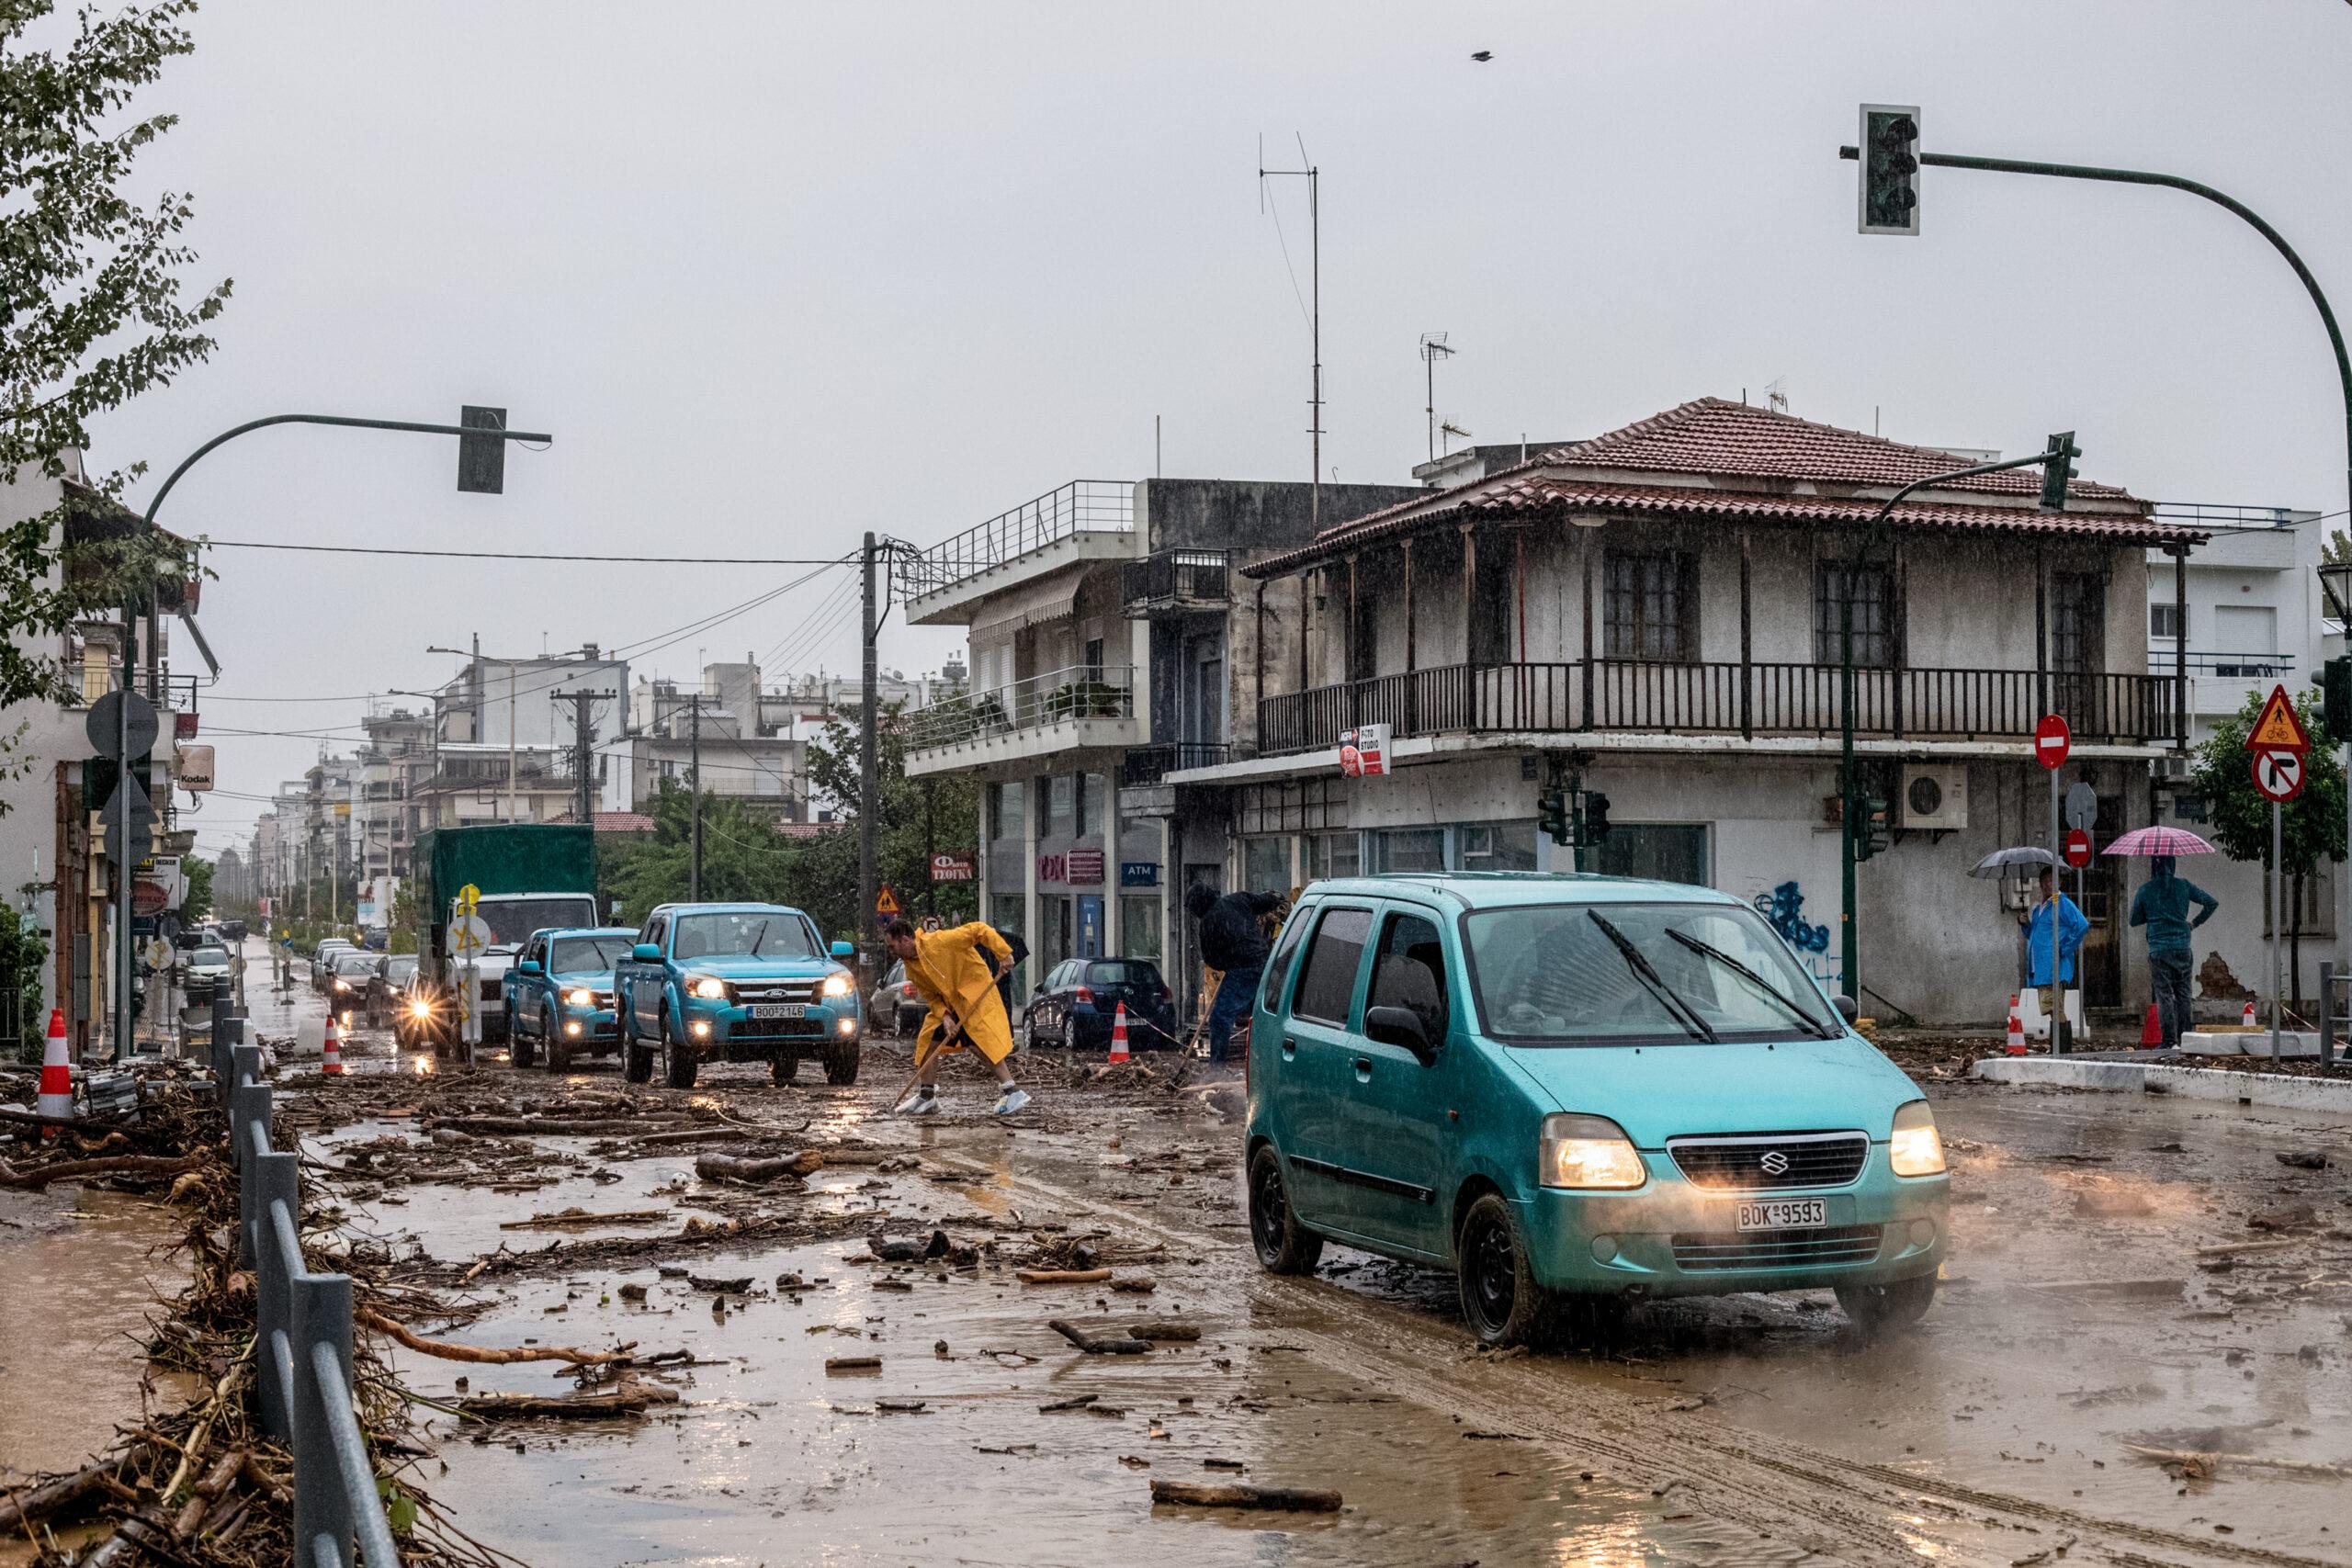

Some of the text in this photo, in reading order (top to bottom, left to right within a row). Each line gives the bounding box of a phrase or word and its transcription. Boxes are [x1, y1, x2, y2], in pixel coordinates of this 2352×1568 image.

[1361, 739, 1379, 750] STUDIO
[181, 774, 210, 784] Kodak
[1127, 866, 1151, 875] ATM
